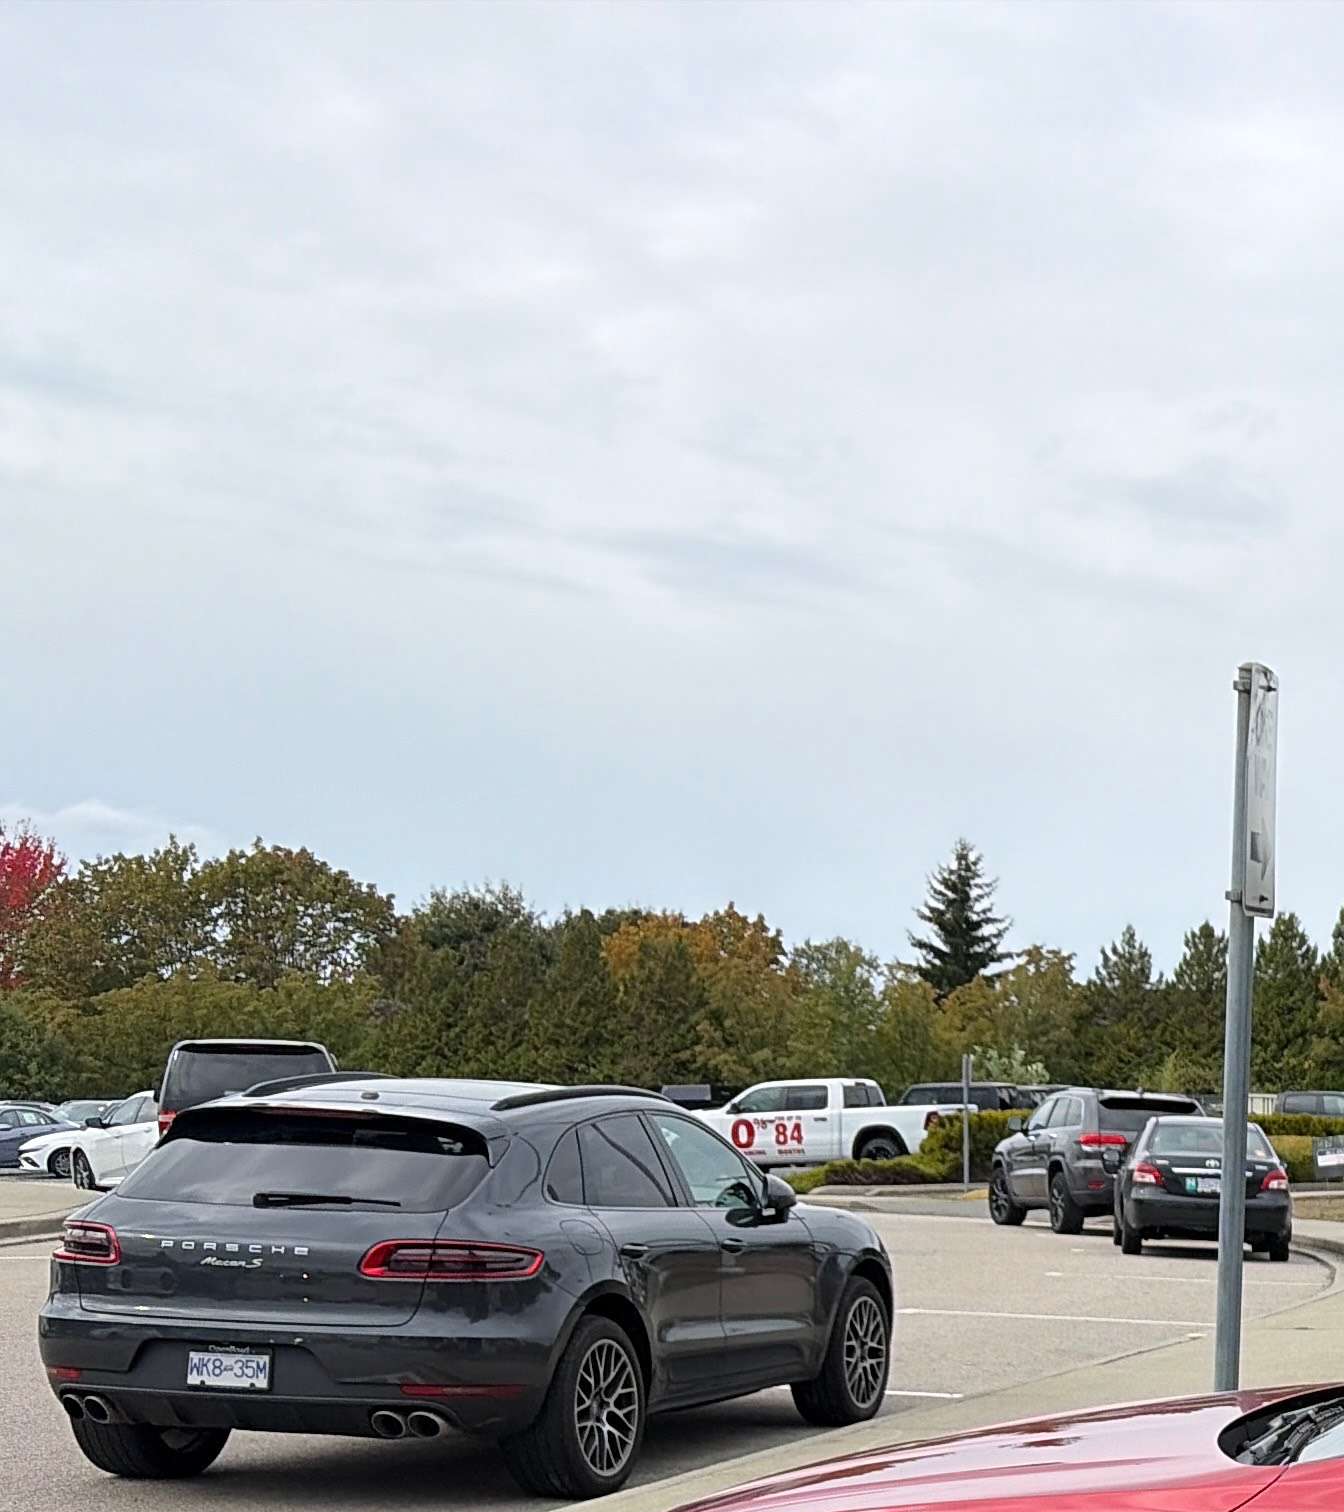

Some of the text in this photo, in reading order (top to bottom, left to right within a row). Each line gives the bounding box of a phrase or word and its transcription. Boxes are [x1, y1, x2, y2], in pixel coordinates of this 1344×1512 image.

[775, 1122, 803, 1145] 84
[161, 1240, 309, 1256] PORSCHE
[201, 1257, 264, 1268] Macan S
